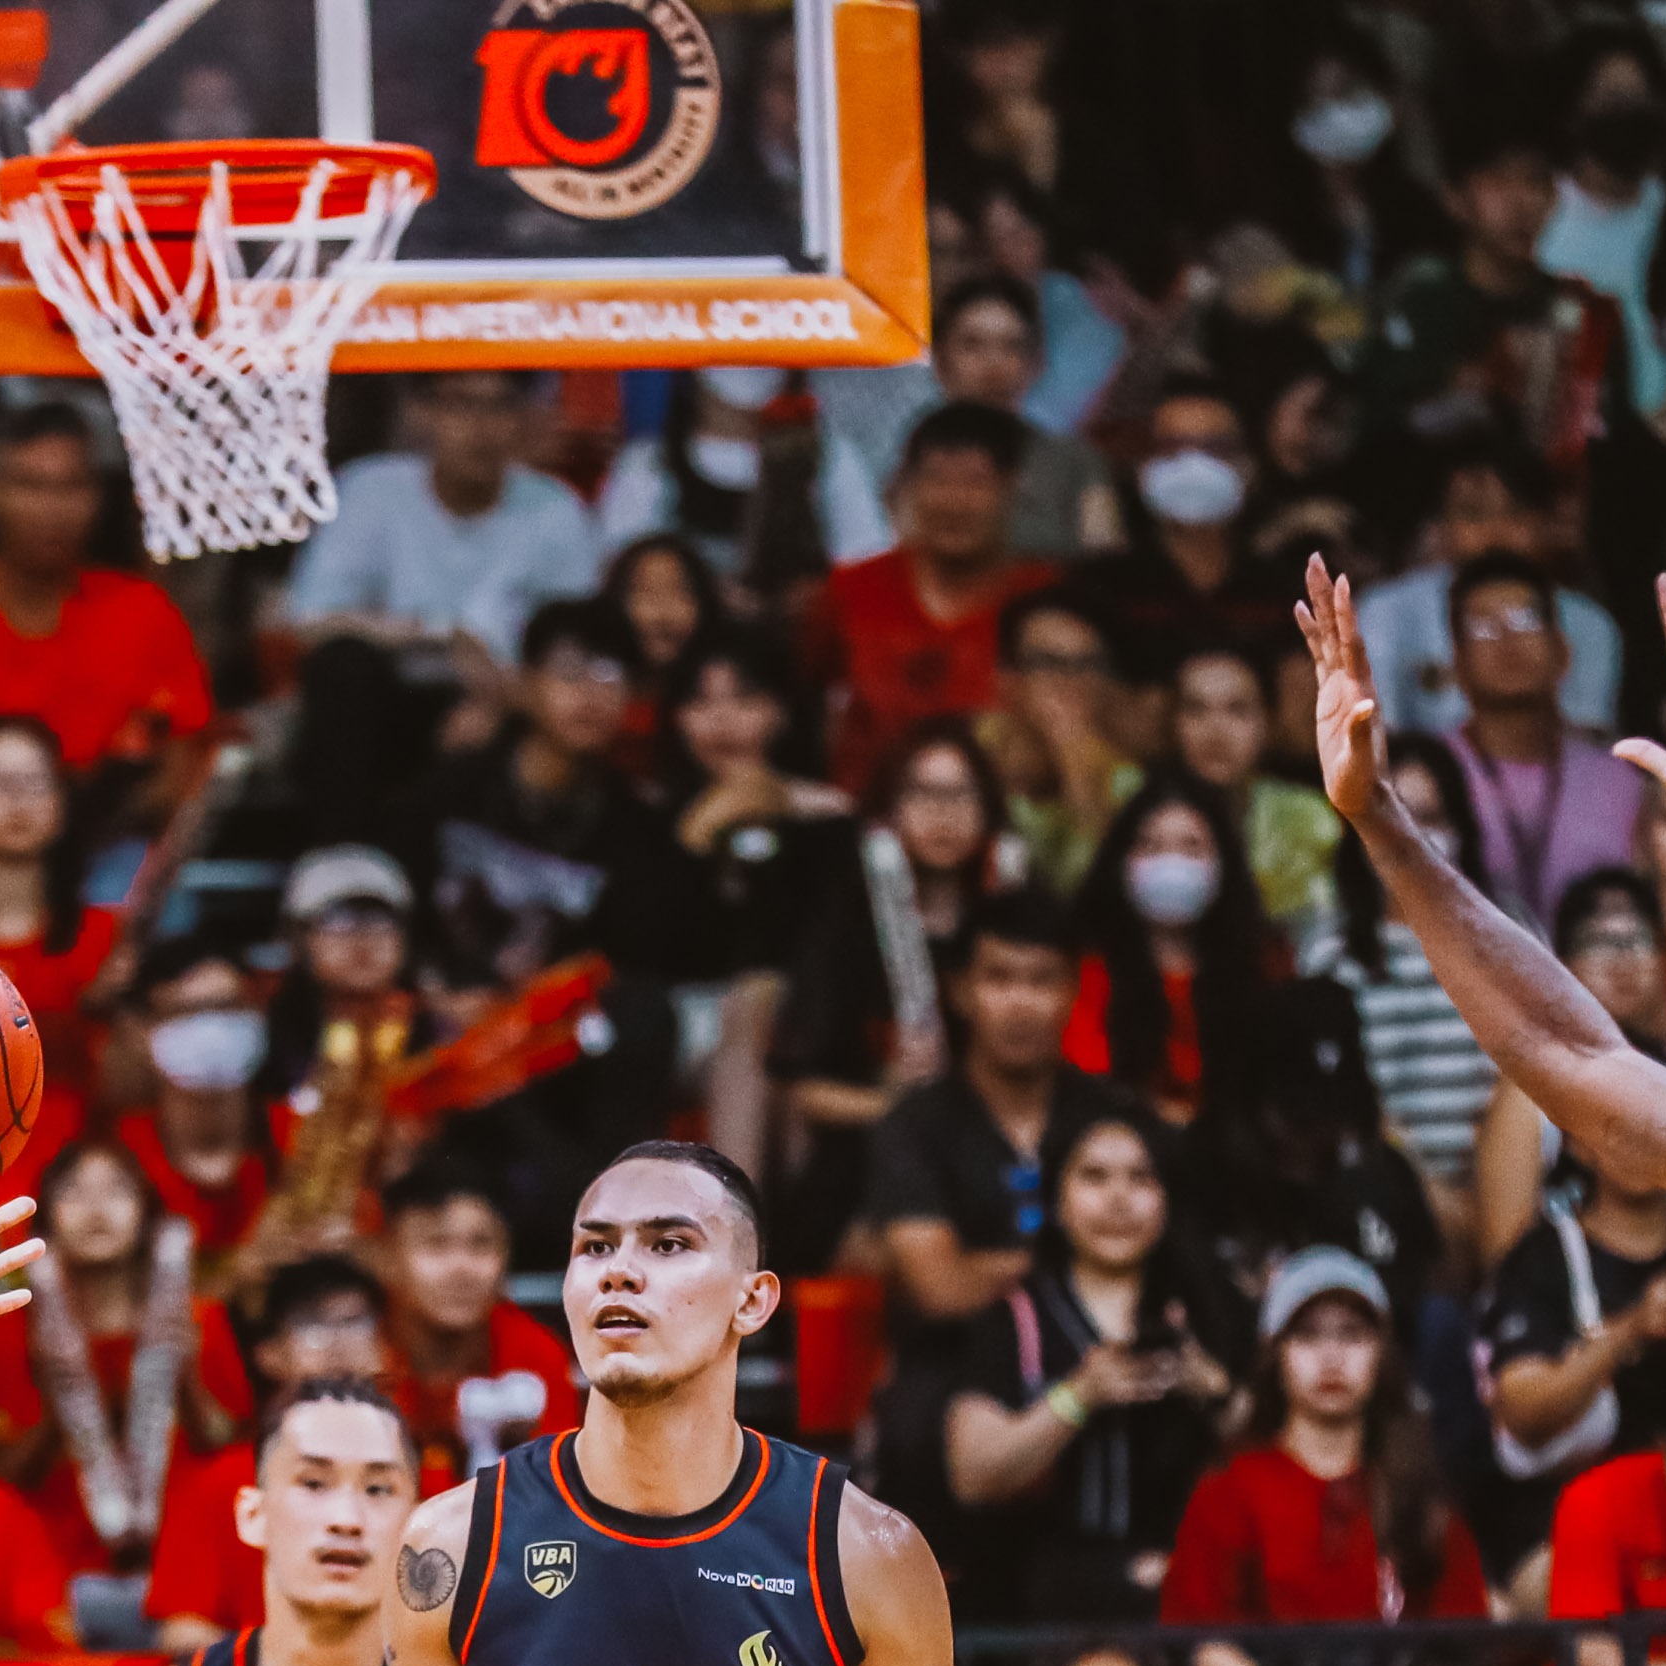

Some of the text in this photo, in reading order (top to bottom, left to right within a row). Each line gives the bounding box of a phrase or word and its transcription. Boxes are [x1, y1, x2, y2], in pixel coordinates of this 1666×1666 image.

[708, 299, 858, 341] SCHOOL
[532, 1546, 573, 1566] VBA
[697, 1567, 795, 1596] NovaWORLD
